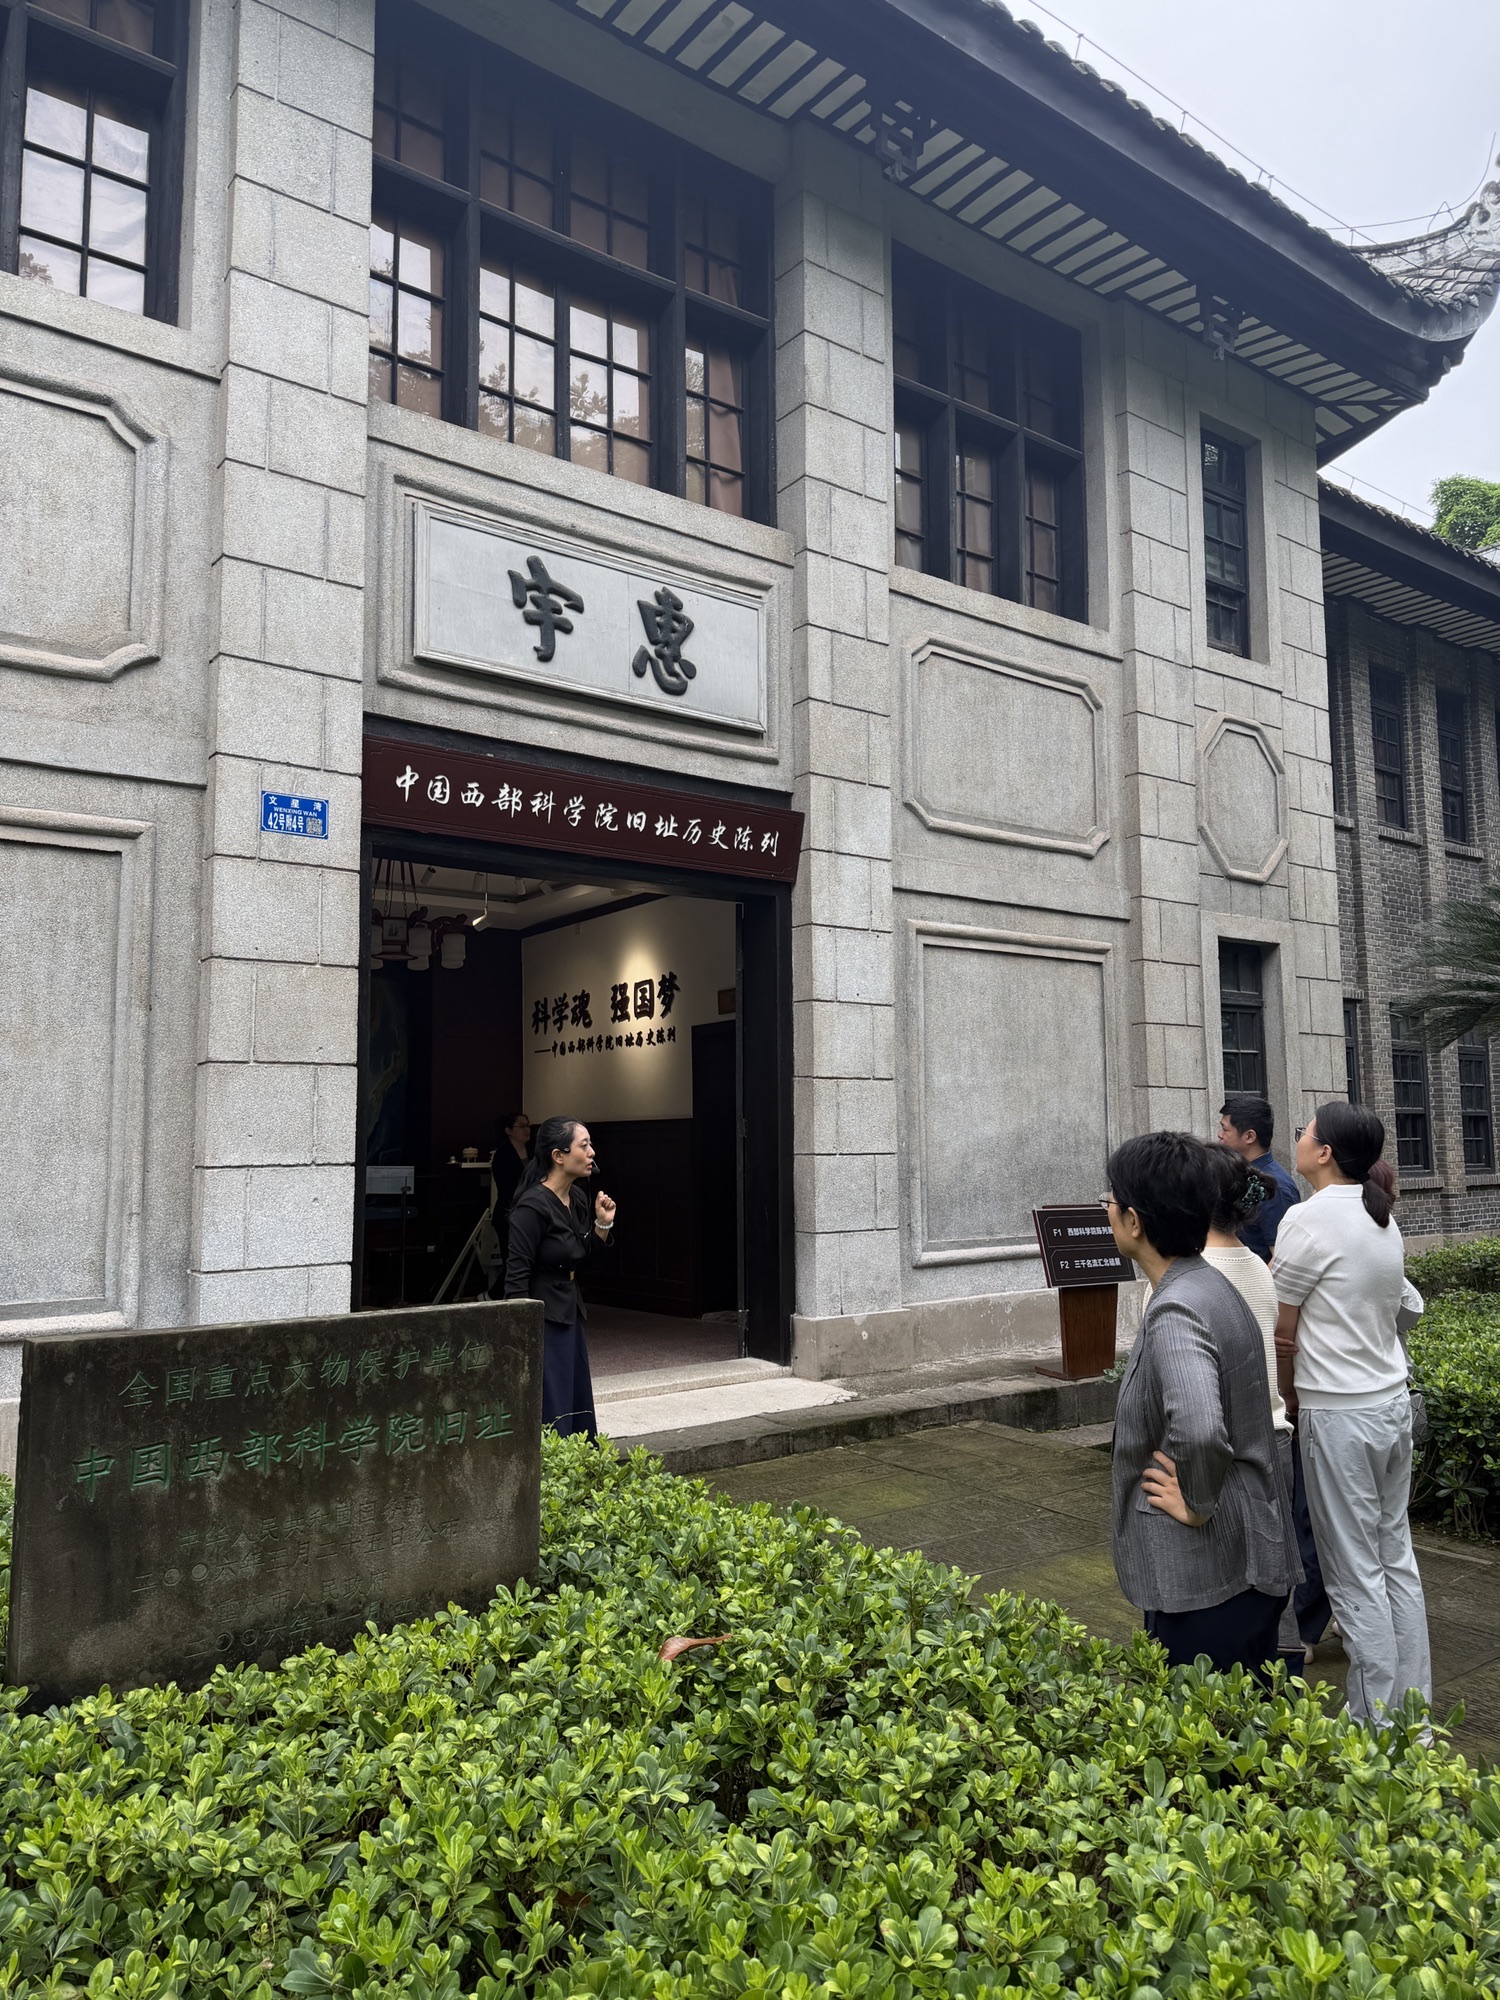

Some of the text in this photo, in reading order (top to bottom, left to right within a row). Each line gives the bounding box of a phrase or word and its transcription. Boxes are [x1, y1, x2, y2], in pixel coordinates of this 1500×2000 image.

[269, 795, 322, 812] 文星湾
[273, 806, 318, 818] WENXING WAN
[395, 765, 780, 858] 中国西部科学院旧址历史陈列
[268, 812, 304, 832] 42号附4号
[531, 971, 681, 1035] 科学魂 强国梦
[1053, 1228, 1062, 1237] F1
[1060, 1261, 1070, 1269] F2
[118, 1340, 489, 1408] 全国重点文物保护单位
[71, 1401, 514, 1502] 中国西部科学院旧址
